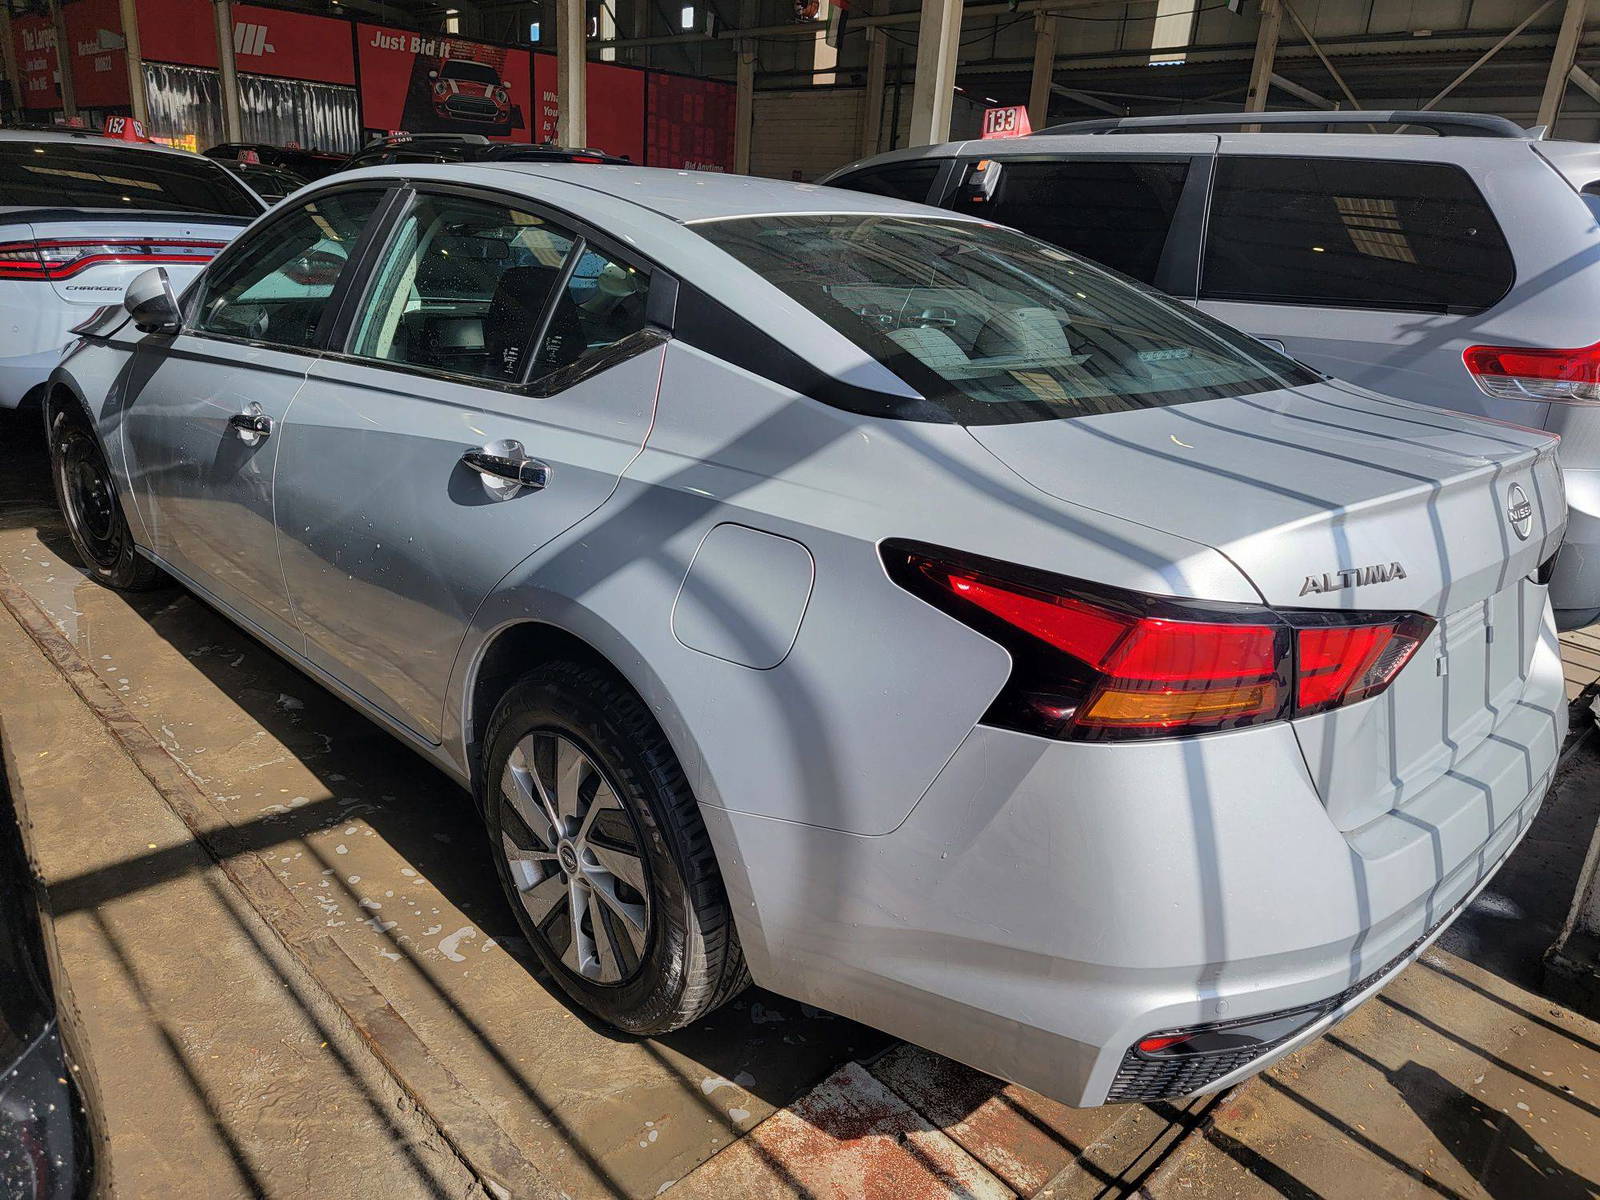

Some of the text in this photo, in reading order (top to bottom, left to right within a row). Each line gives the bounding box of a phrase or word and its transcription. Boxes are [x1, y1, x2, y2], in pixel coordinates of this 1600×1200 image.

[370, 31, 451, 58] Just Bid It
[108, 118, 125, 134] 152
[989, 109, 1016, 132] 133
[1299, 561, 1408, 597] ALTIMA
